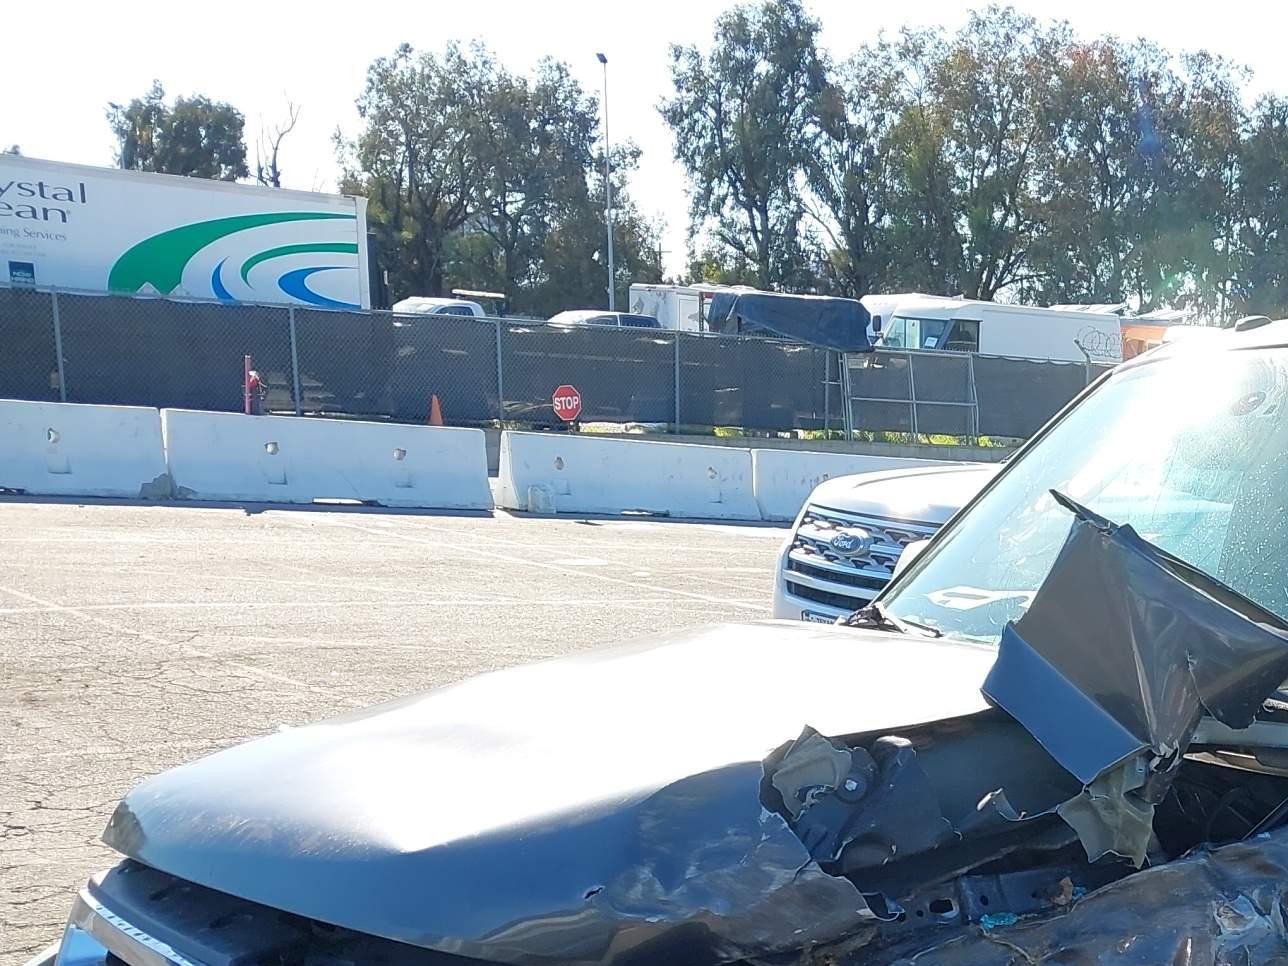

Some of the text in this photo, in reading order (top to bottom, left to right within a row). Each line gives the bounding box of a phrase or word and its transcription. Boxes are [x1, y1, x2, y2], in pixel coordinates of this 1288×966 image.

[24, 227, 67, 240] Services
[554, 396, 579, 410] STOP
[833, 533, 853, 549] Ford
